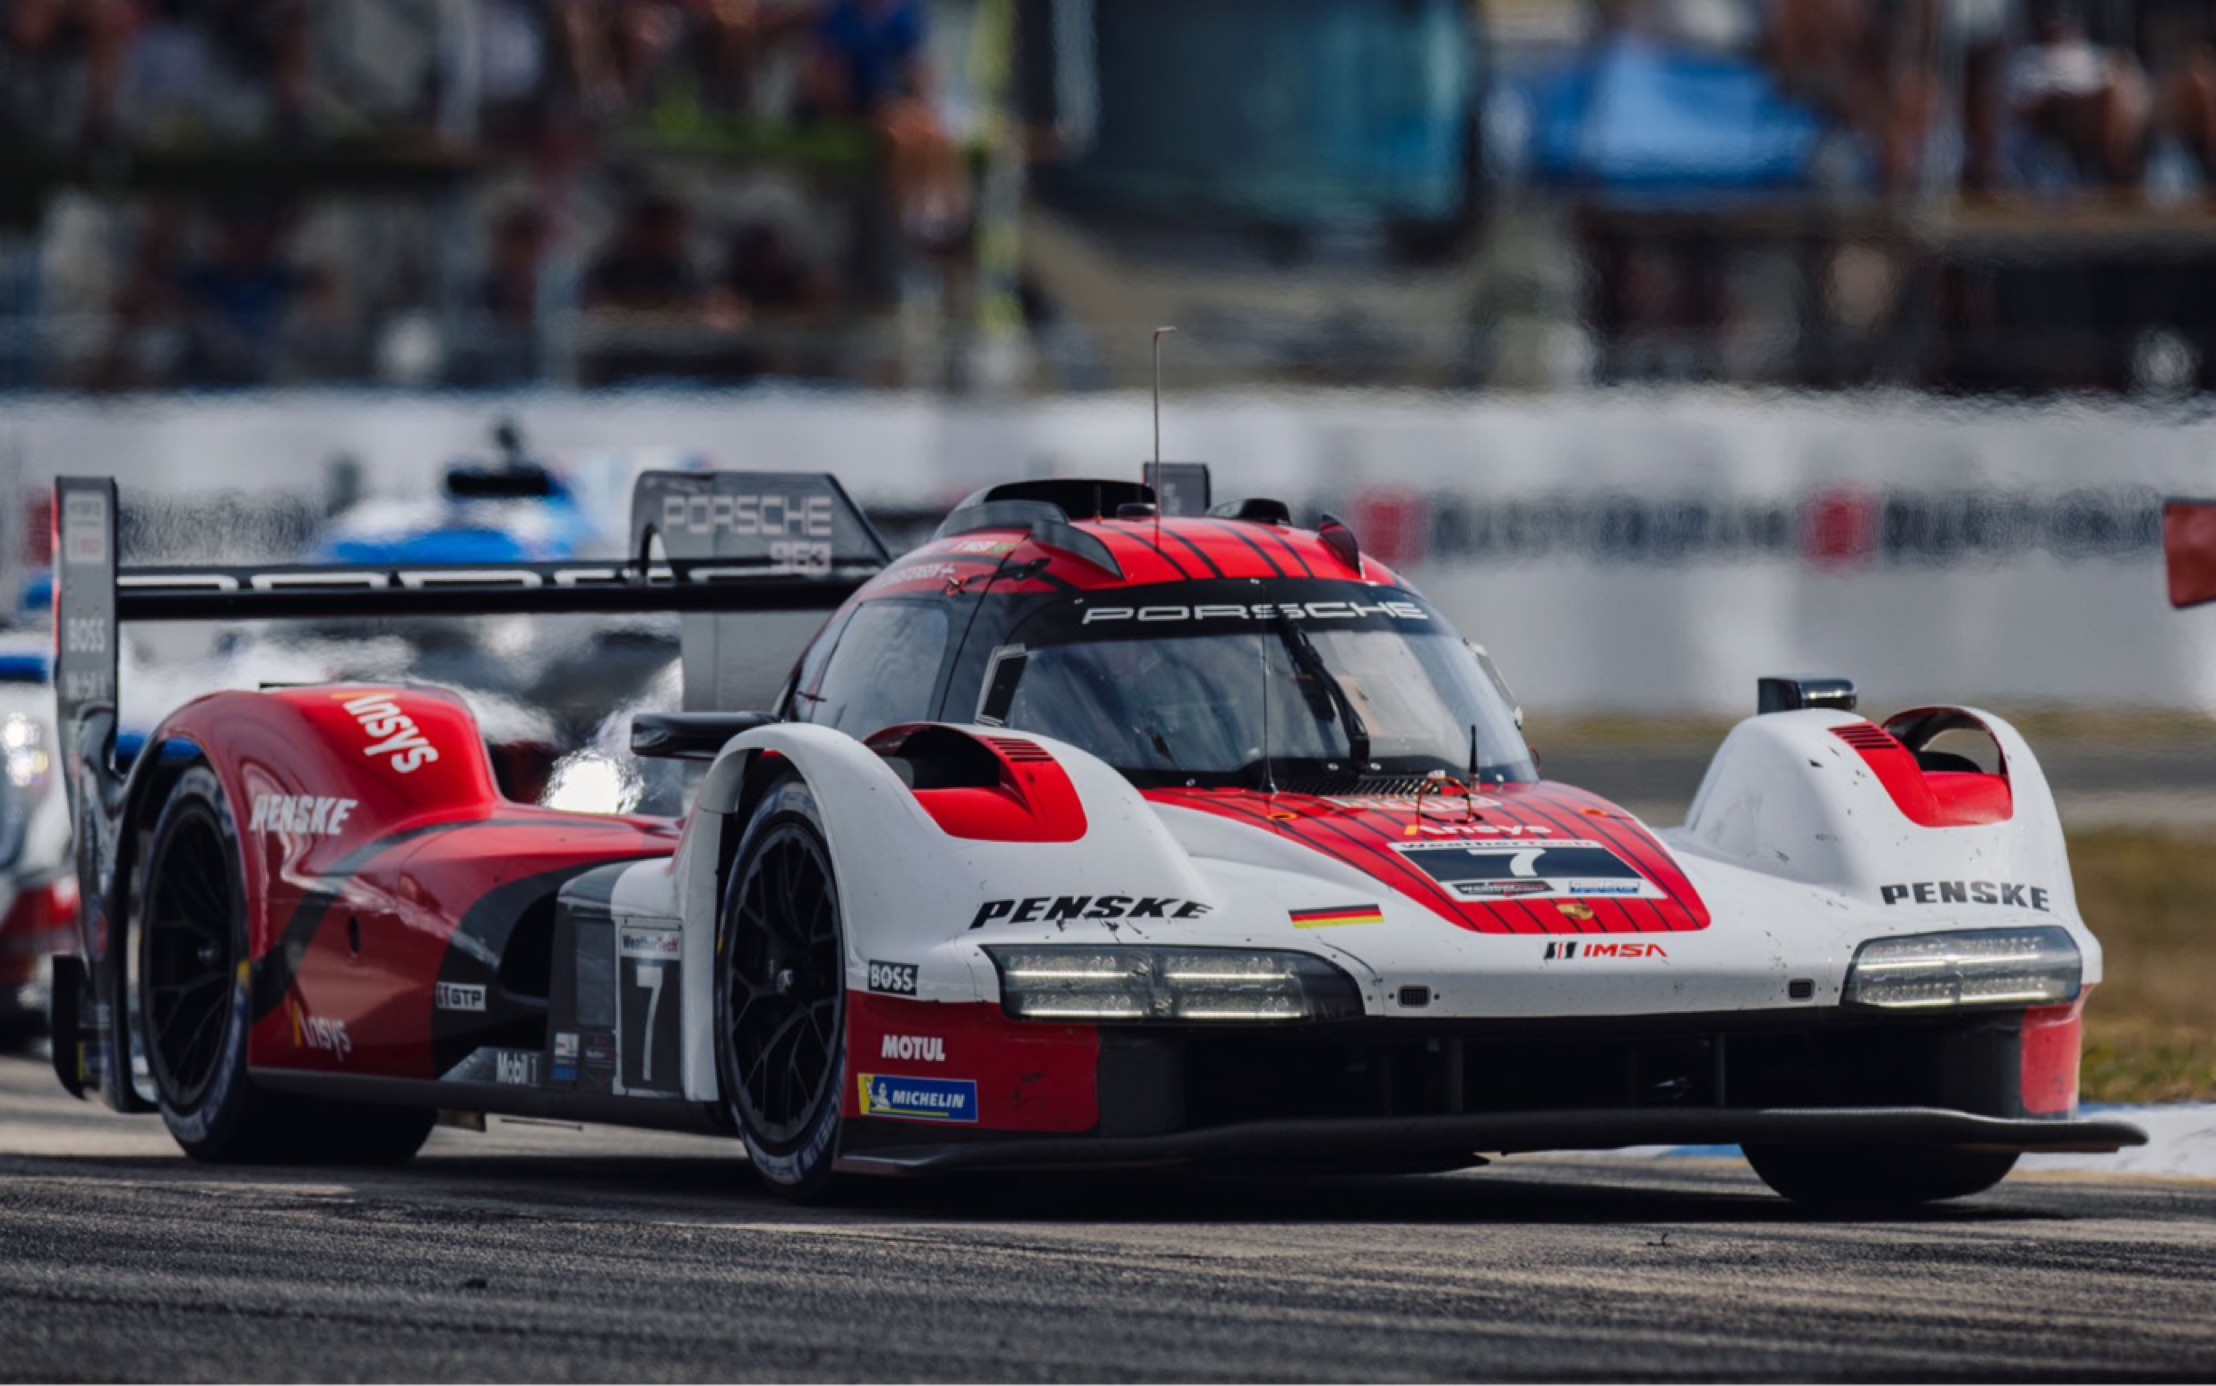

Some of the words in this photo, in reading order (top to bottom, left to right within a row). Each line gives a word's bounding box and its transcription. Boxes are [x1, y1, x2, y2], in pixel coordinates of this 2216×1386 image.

[662, 495, 832, 536] PORSCHE
[770, 541, 832, 575] 963
[1081, 601, 1429, 625] PORSCHE
[248, 794, 358, 835] PENSKE
[1466, 849, 1547, 878] 7
[1879, 877, 2051, 913] PENSKE
[969, 895, 1214, 930] PENSKE
[1583, 943, 1668, 959] IMSA
[871, 964, 914, 992] BOSS
[451, 987, 482, 1008] GTP
[636, 965, 664, 1081] 7
[881, 1034, 946, 1062] MOTUL
[891, 1089, 966, 1109] MICHELIN
